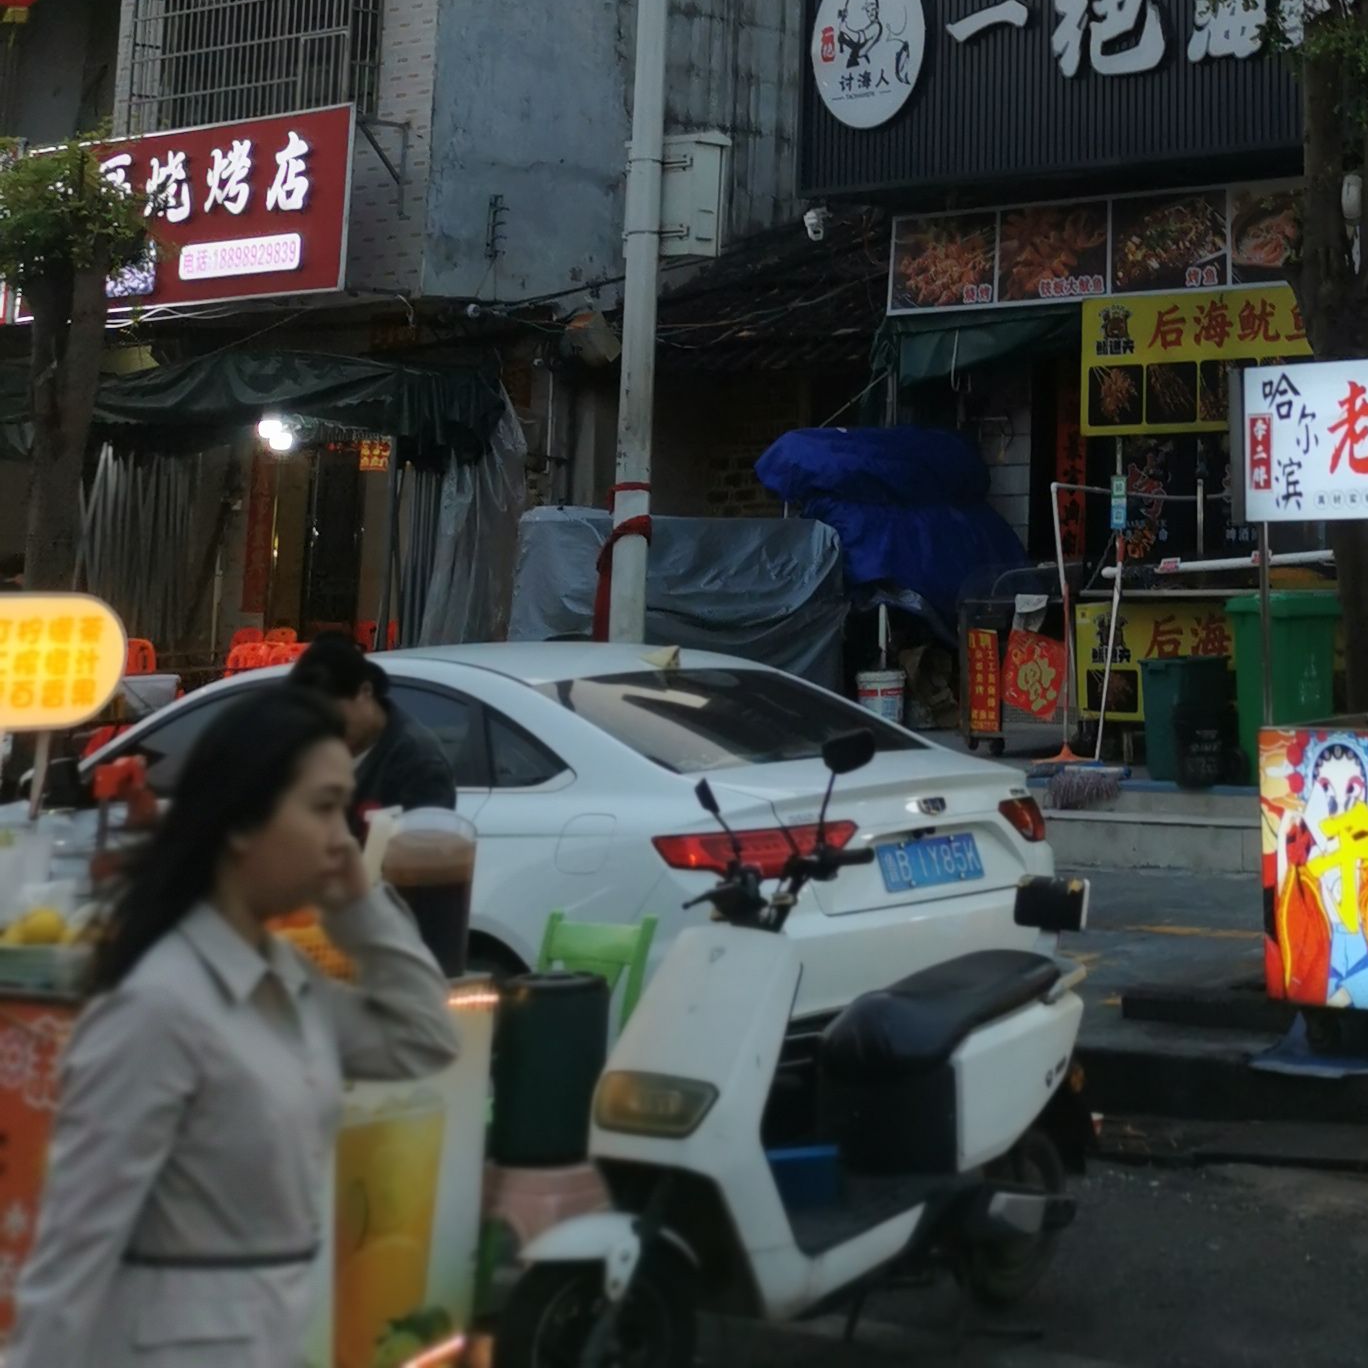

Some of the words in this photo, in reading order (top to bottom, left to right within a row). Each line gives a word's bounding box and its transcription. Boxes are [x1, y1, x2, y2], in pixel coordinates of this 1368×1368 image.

[839, 69, 890, 92] 讨海人
[1261, 372, 1319, 510] 哈尔滨
[1145, 615, 1232, 659] 后海
